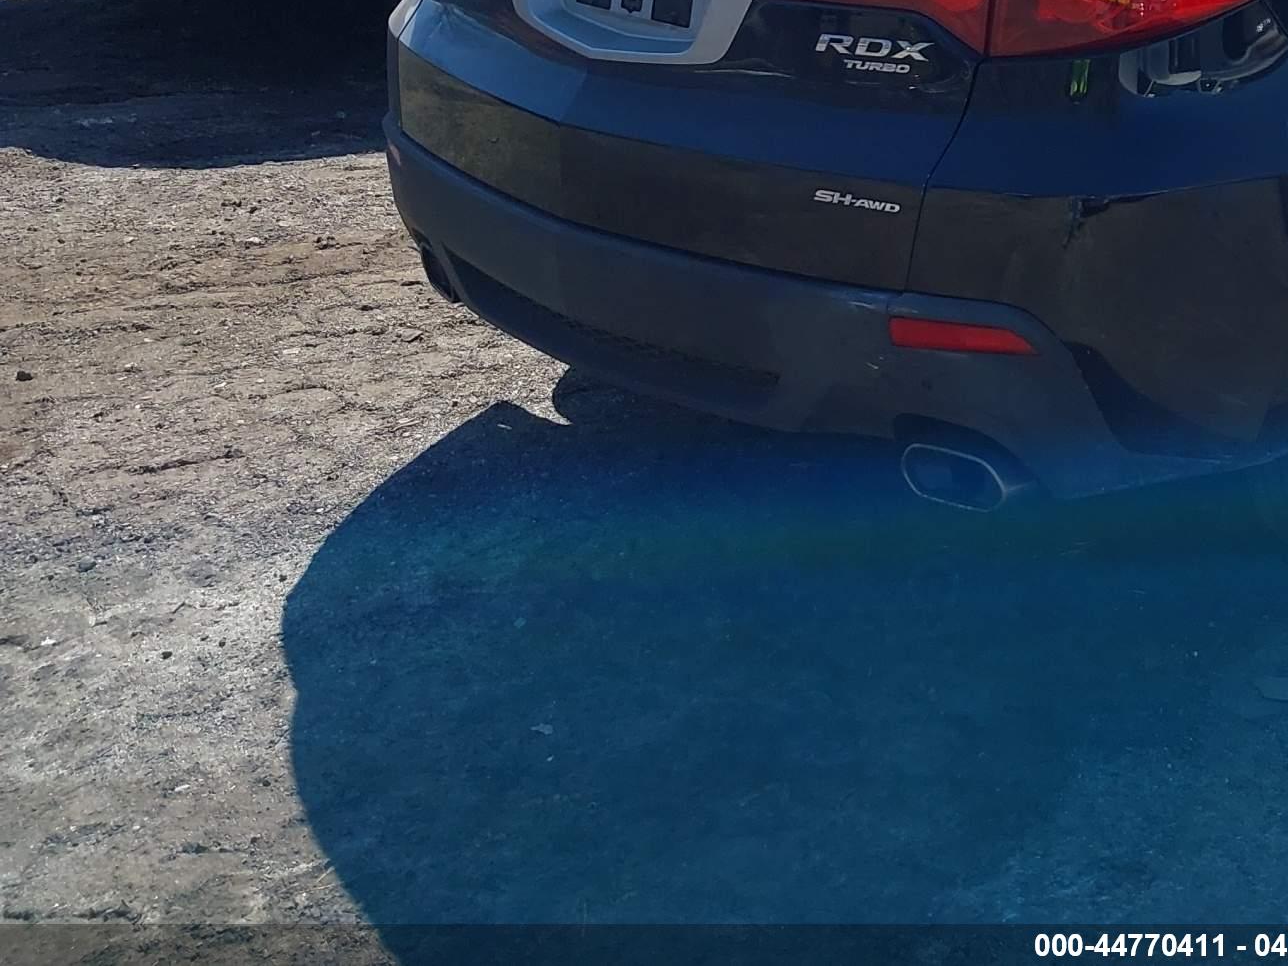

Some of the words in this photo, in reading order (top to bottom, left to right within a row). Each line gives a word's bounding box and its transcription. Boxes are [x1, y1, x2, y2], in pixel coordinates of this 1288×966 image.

[815, 33, 935, 62] RDX
[843, 58, 911, 74] TURBO
[813, 189, 901, 213] SH-AWD
